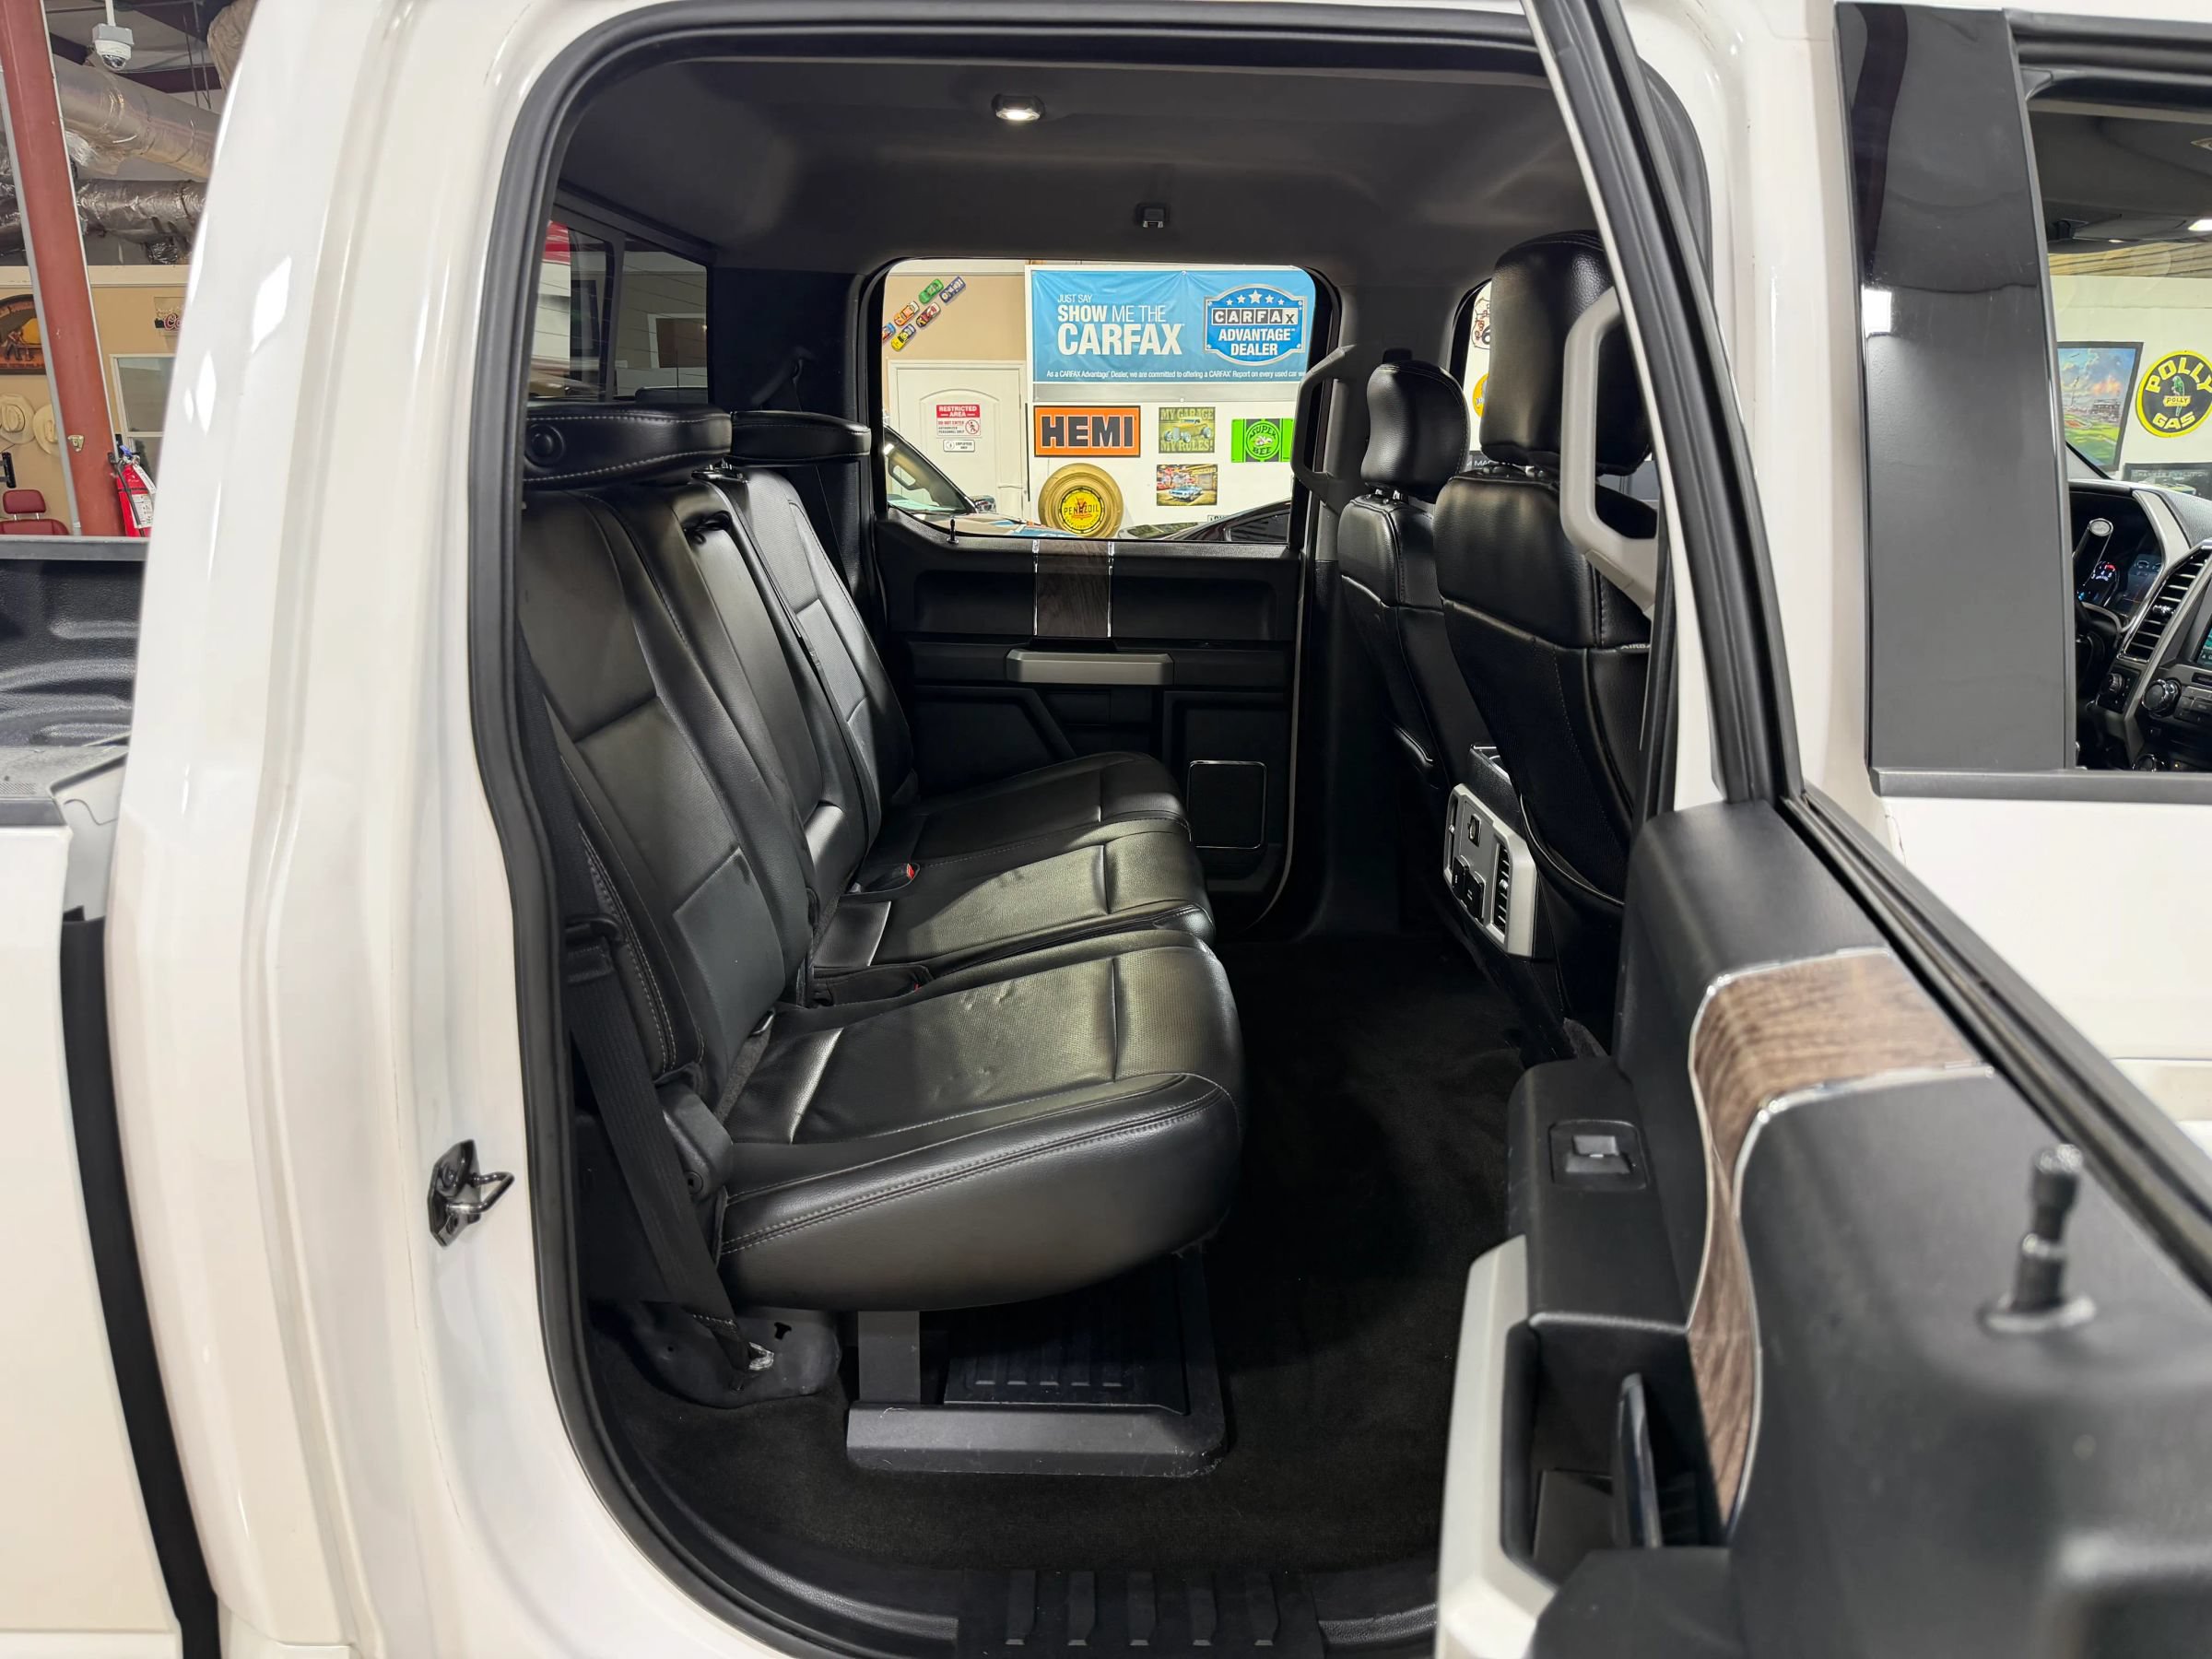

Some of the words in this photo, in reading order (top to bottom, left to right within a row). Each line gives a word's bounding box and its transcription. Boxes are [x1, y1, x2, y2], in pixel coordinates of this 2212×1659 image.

[1057, 294, 1076, 303] JUST
[1077, 294, 1092, 303] SAY
[1057, 305, 1108, 323] SHOW
[1112, 305, 1135, 323] ME
[1138, 305, 1166, 323] THE
[1214, 310, 1296, 324] CARFAX
[1057, 323, 1182, 356] CARFAX
[1218, 328, 1291, 342] ADVANTAGE
[1230, 343, 1278, 356] DEALER
[1111, 371, 1129, 379] Dealer,
[1182, 371, 1203, 379] offering
[1232, 371, 1251, 379] Report
[2145, 357, 2212, 394] POLLY
[1160, 408, 1176, 420] MY
[1177, 408, 1214, 420] GARAGE
[2152, 411, 2195, 429] GAS
[1041, 415, 1135, 448] HEMI
[1249, 425, 1277, 439] SUPER
[1160, 441, 1177, 452] MY
[1179, 440, 1214, 453] RULES!
[1253, 446, 1272, 455] BEE
